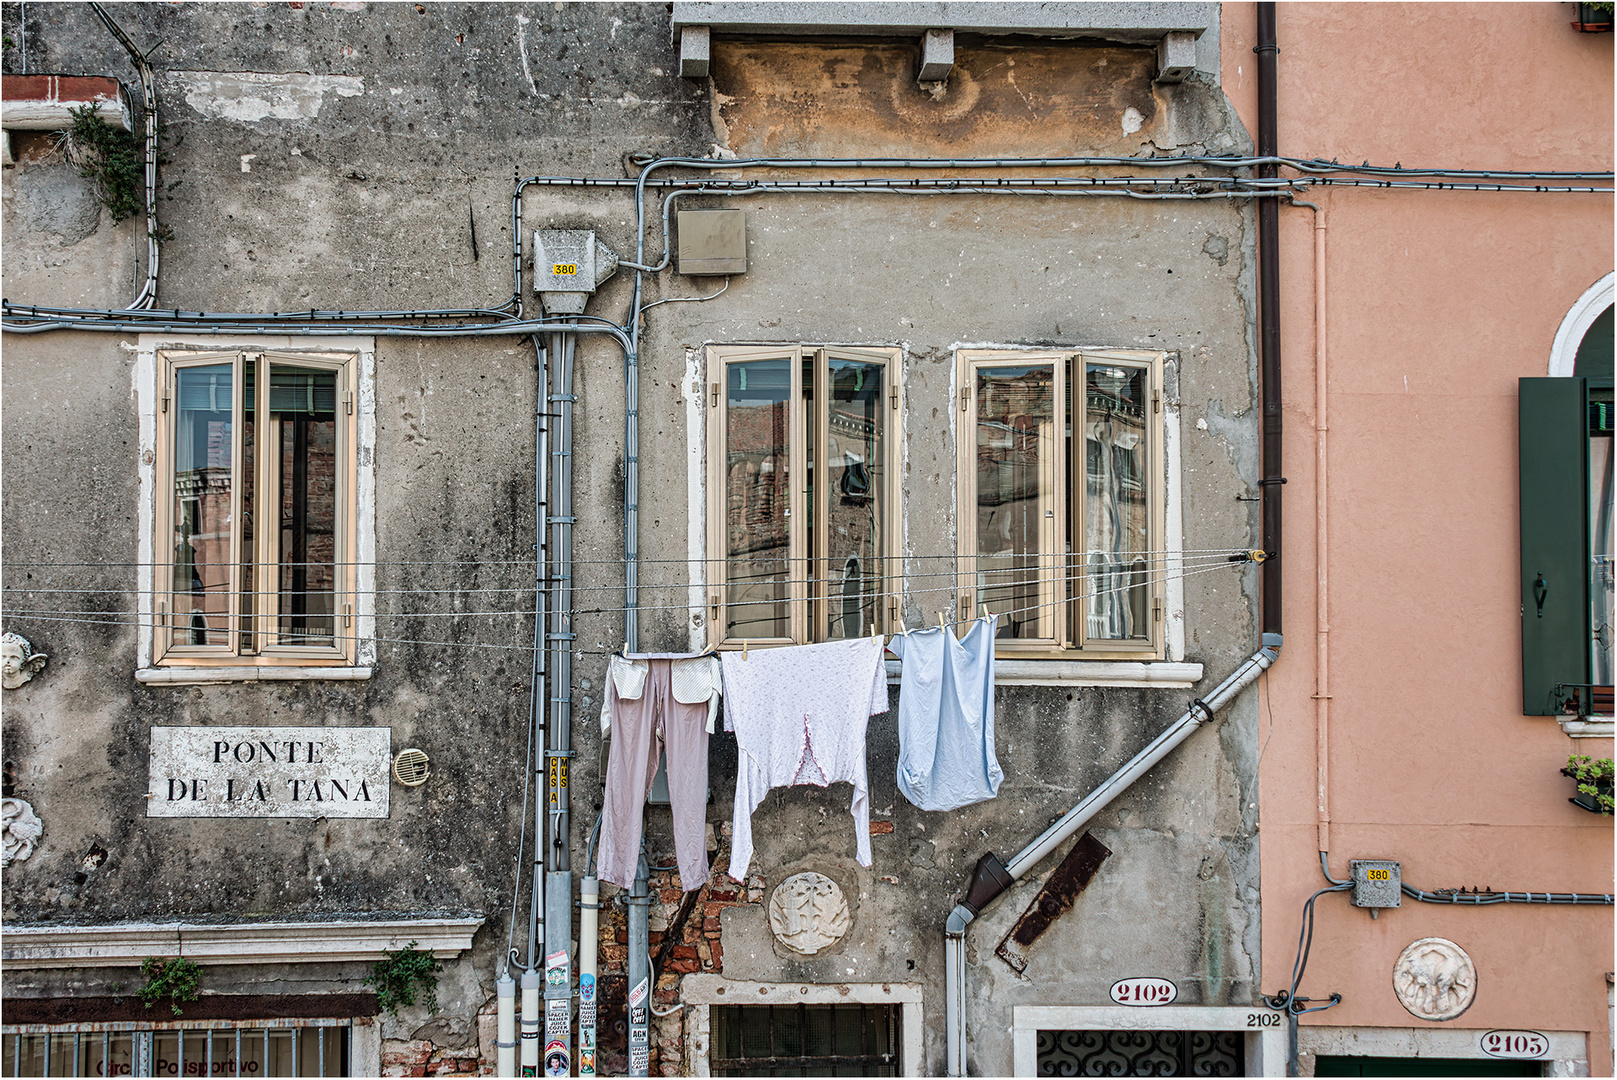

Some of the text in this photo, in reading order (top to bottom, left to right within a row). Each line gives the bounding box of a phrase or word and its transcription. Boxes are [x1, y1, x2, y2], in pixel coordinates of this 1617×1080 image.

[555, 265, 575, 274] 380
[213, 741, 324, 764] PONTE
[167, 778, 372, 802] DE LA TANA
[1370, 870, 1388, 880] 380
[1117, 984, 1171, 1002] 2102
[1247, 1014, 1281, 1027] 2102
[1488, 1034, 1542, 1054] 2103
[156, 1058, 259, 1077] Poisportivo
